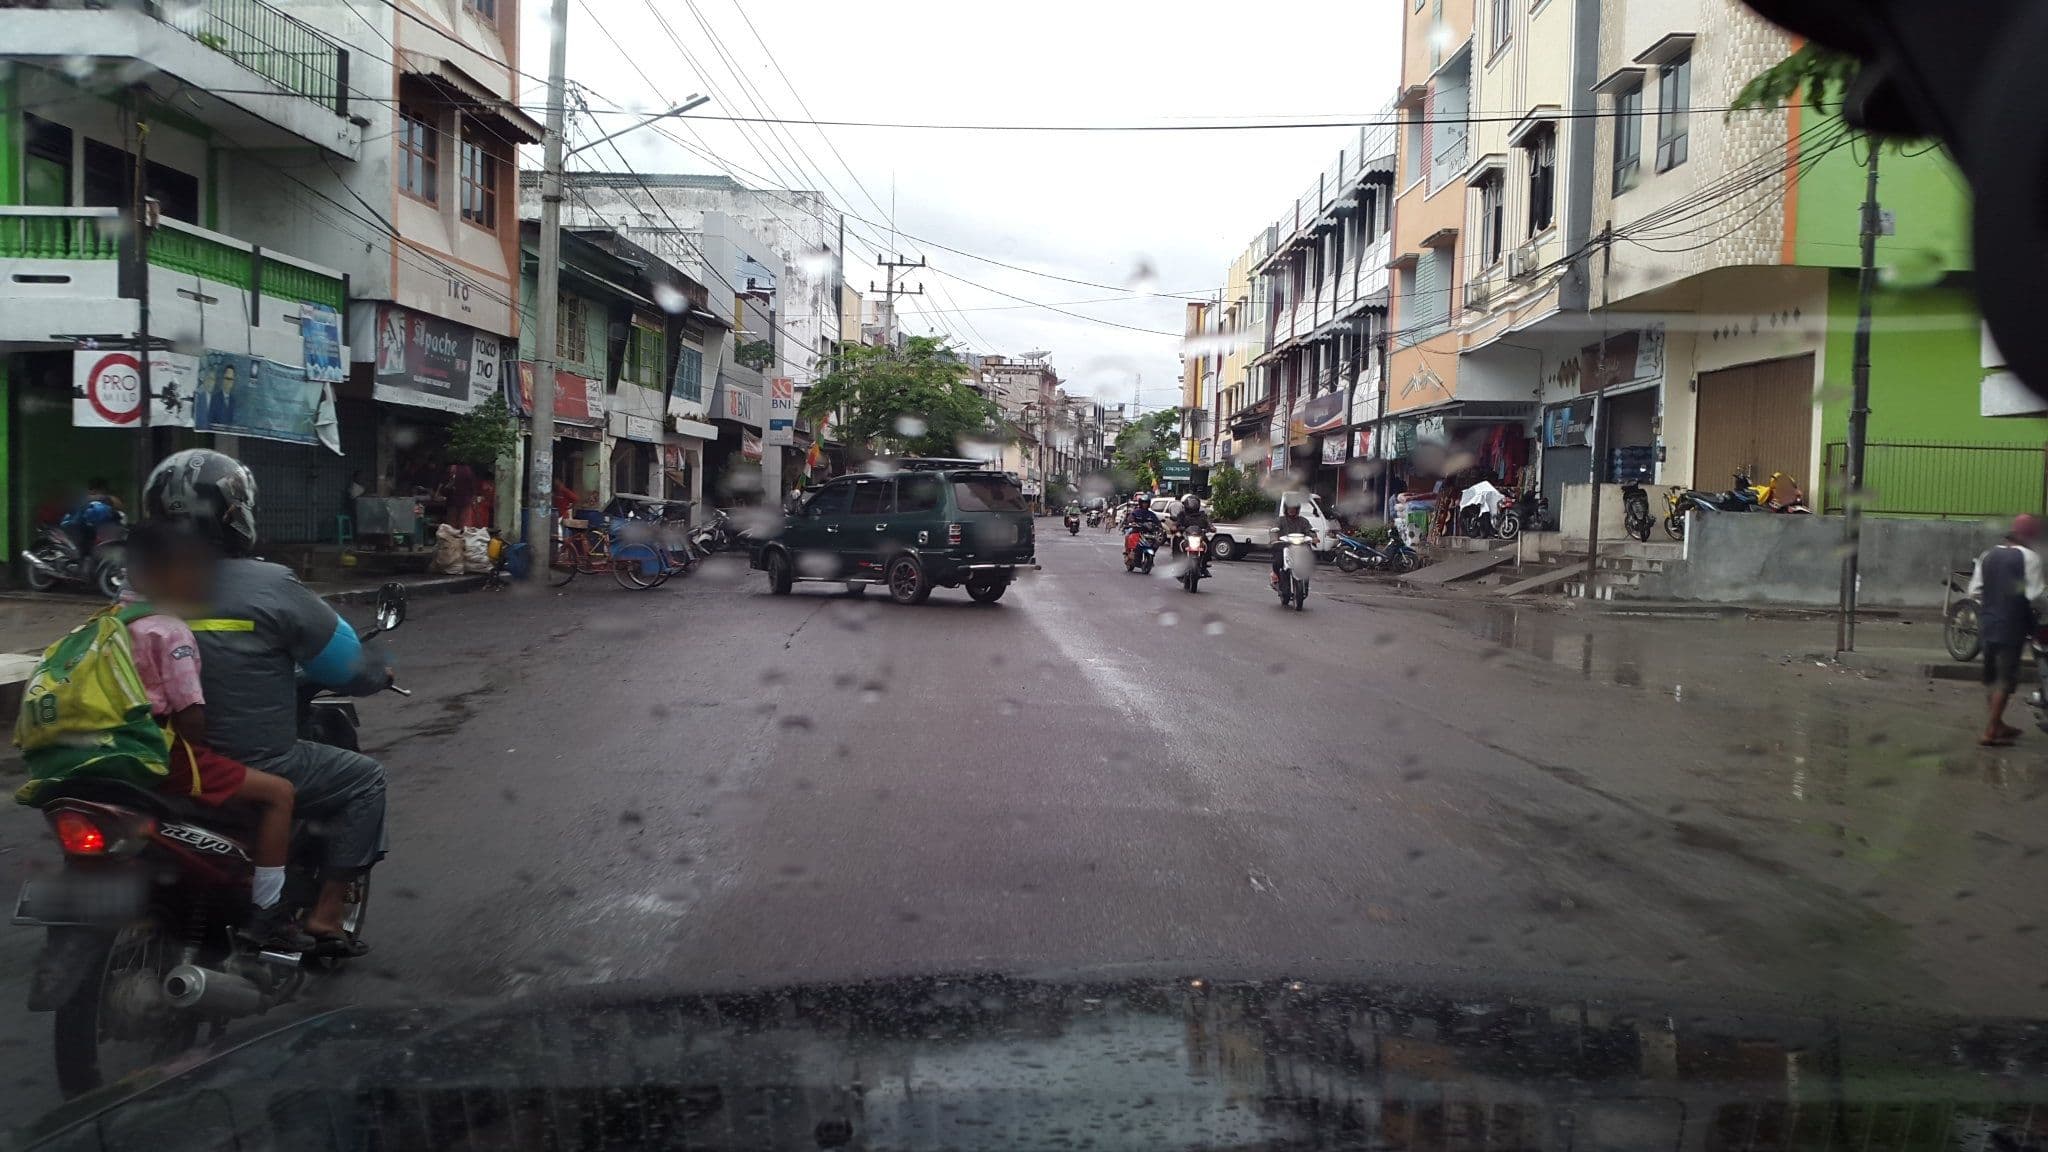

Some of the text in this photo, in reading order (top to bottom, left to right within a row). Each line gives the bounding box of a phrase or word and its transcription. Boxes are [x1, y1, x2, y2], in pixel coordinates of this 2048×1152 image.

[413, 319, 458, 358] Apache
[475, 338, 497, 358] TOKO
[102, 374, 137, 391] PRO
[771, 399, 792, 410] BNI
